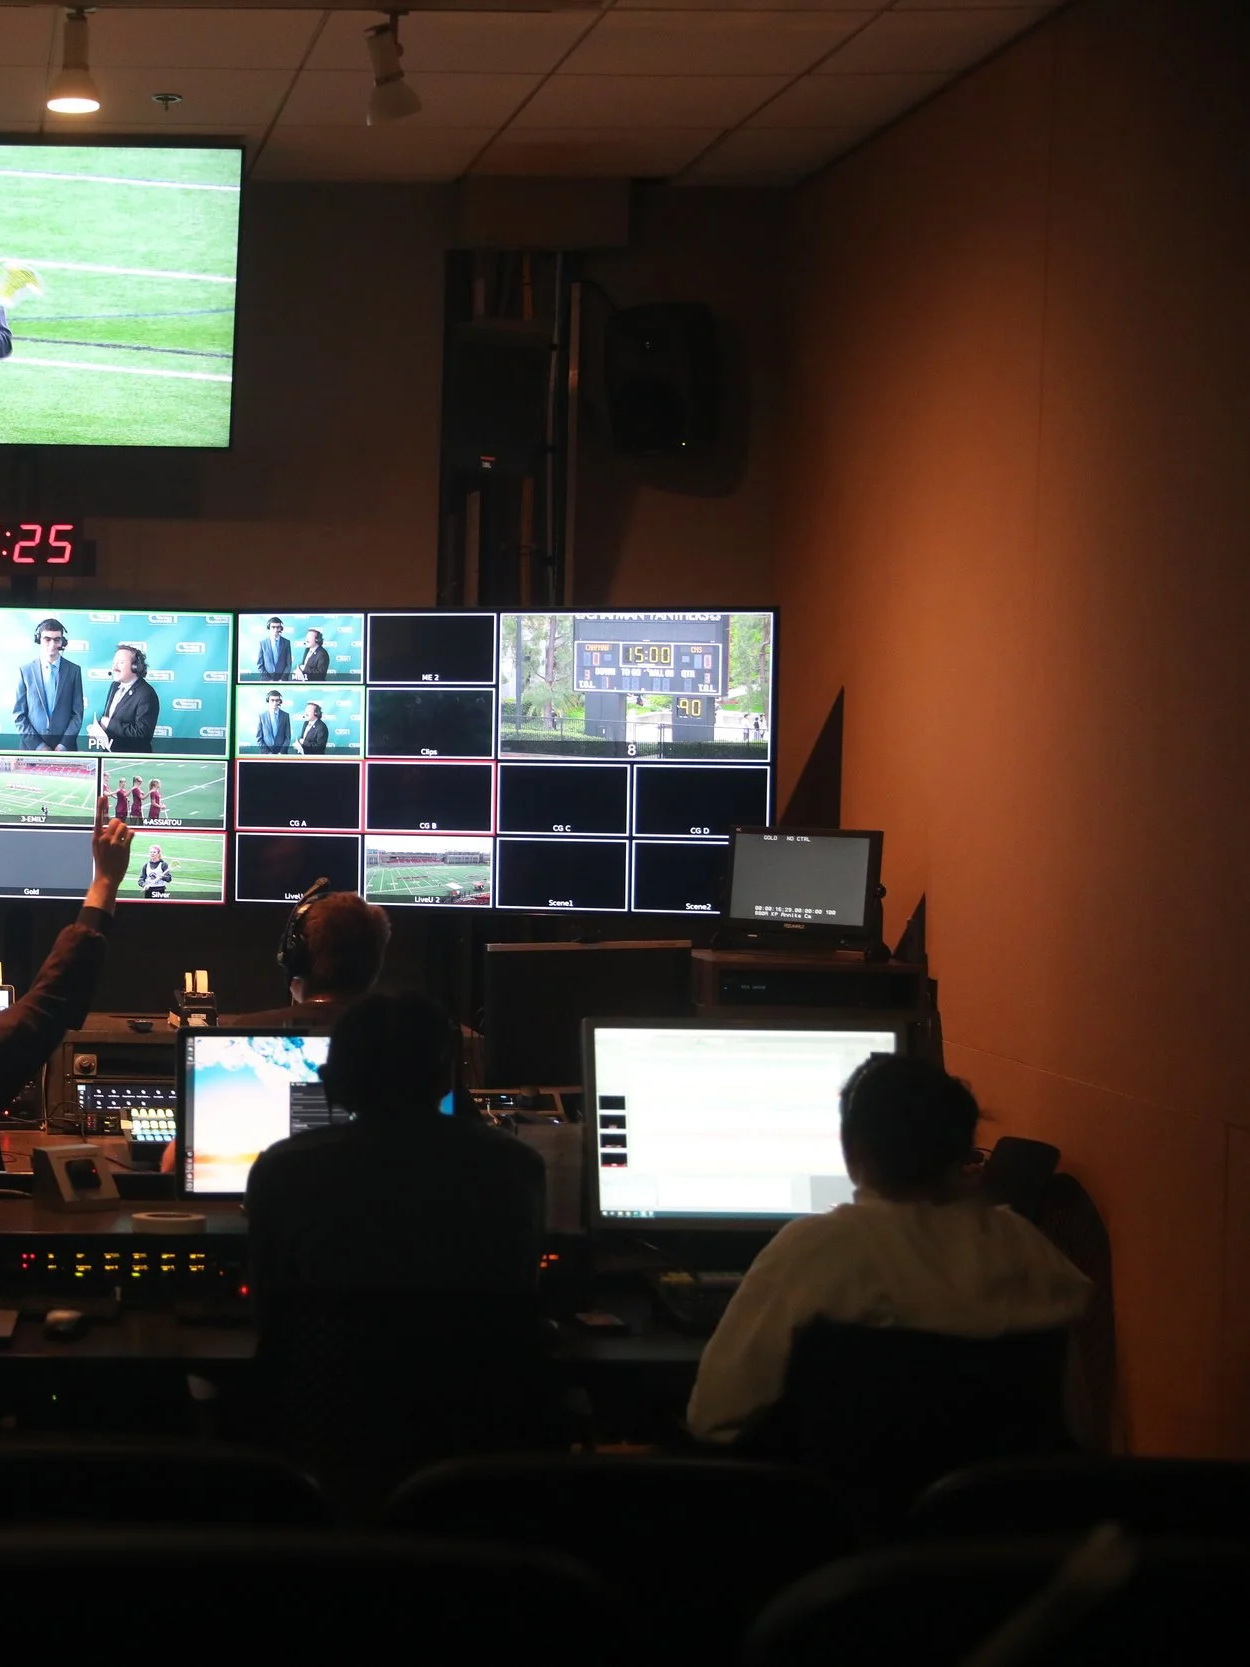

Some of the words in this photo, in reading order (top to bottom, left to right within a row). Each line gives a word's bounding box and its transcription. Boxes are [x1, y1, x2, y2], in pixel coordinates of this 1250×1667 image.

[629, 646, 670, 664] 15:00
[679, 698, 702, 717] 90
[88, 738, 114, 749] PRV
[420, 748, 438, 757] Clips
[627, 744, 636, 756] 8
[20, 815, 46, 823] 3-EMILY
[143, 818, 182, 827] 4-ASSIATOU
[552, 824, 564, 832] CG
[690, 827, 702, 835] CG
[703, 827, 710, 835] D
[23, 888, 40, 896] Gold
[151, 891, 171, 899] Silver
[548, 899, 573, 907] Scene1
[685, 903, 712, 911] Scene2
